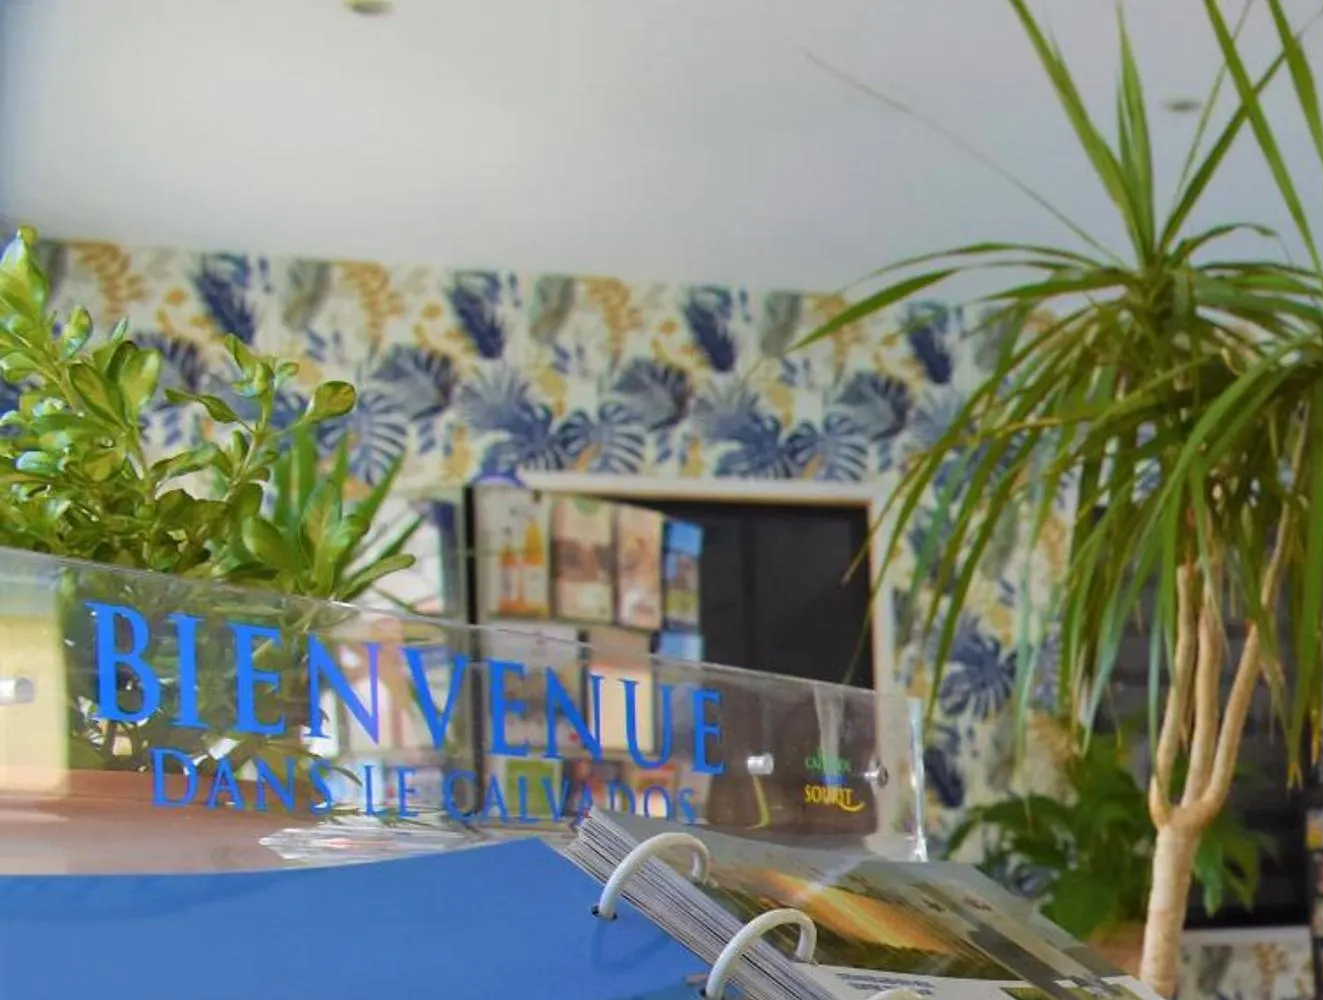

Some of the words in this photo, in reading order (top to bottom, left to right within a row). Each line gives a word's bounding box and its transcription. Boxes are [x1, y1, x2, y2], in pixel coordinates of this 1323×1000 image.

[85, 599, 725, 774] BIENVENUE
[149, 746, 334, 816] DANS
[363, 764, 420, 818] LE
[441, 768, 700, 830] CALVADOS
